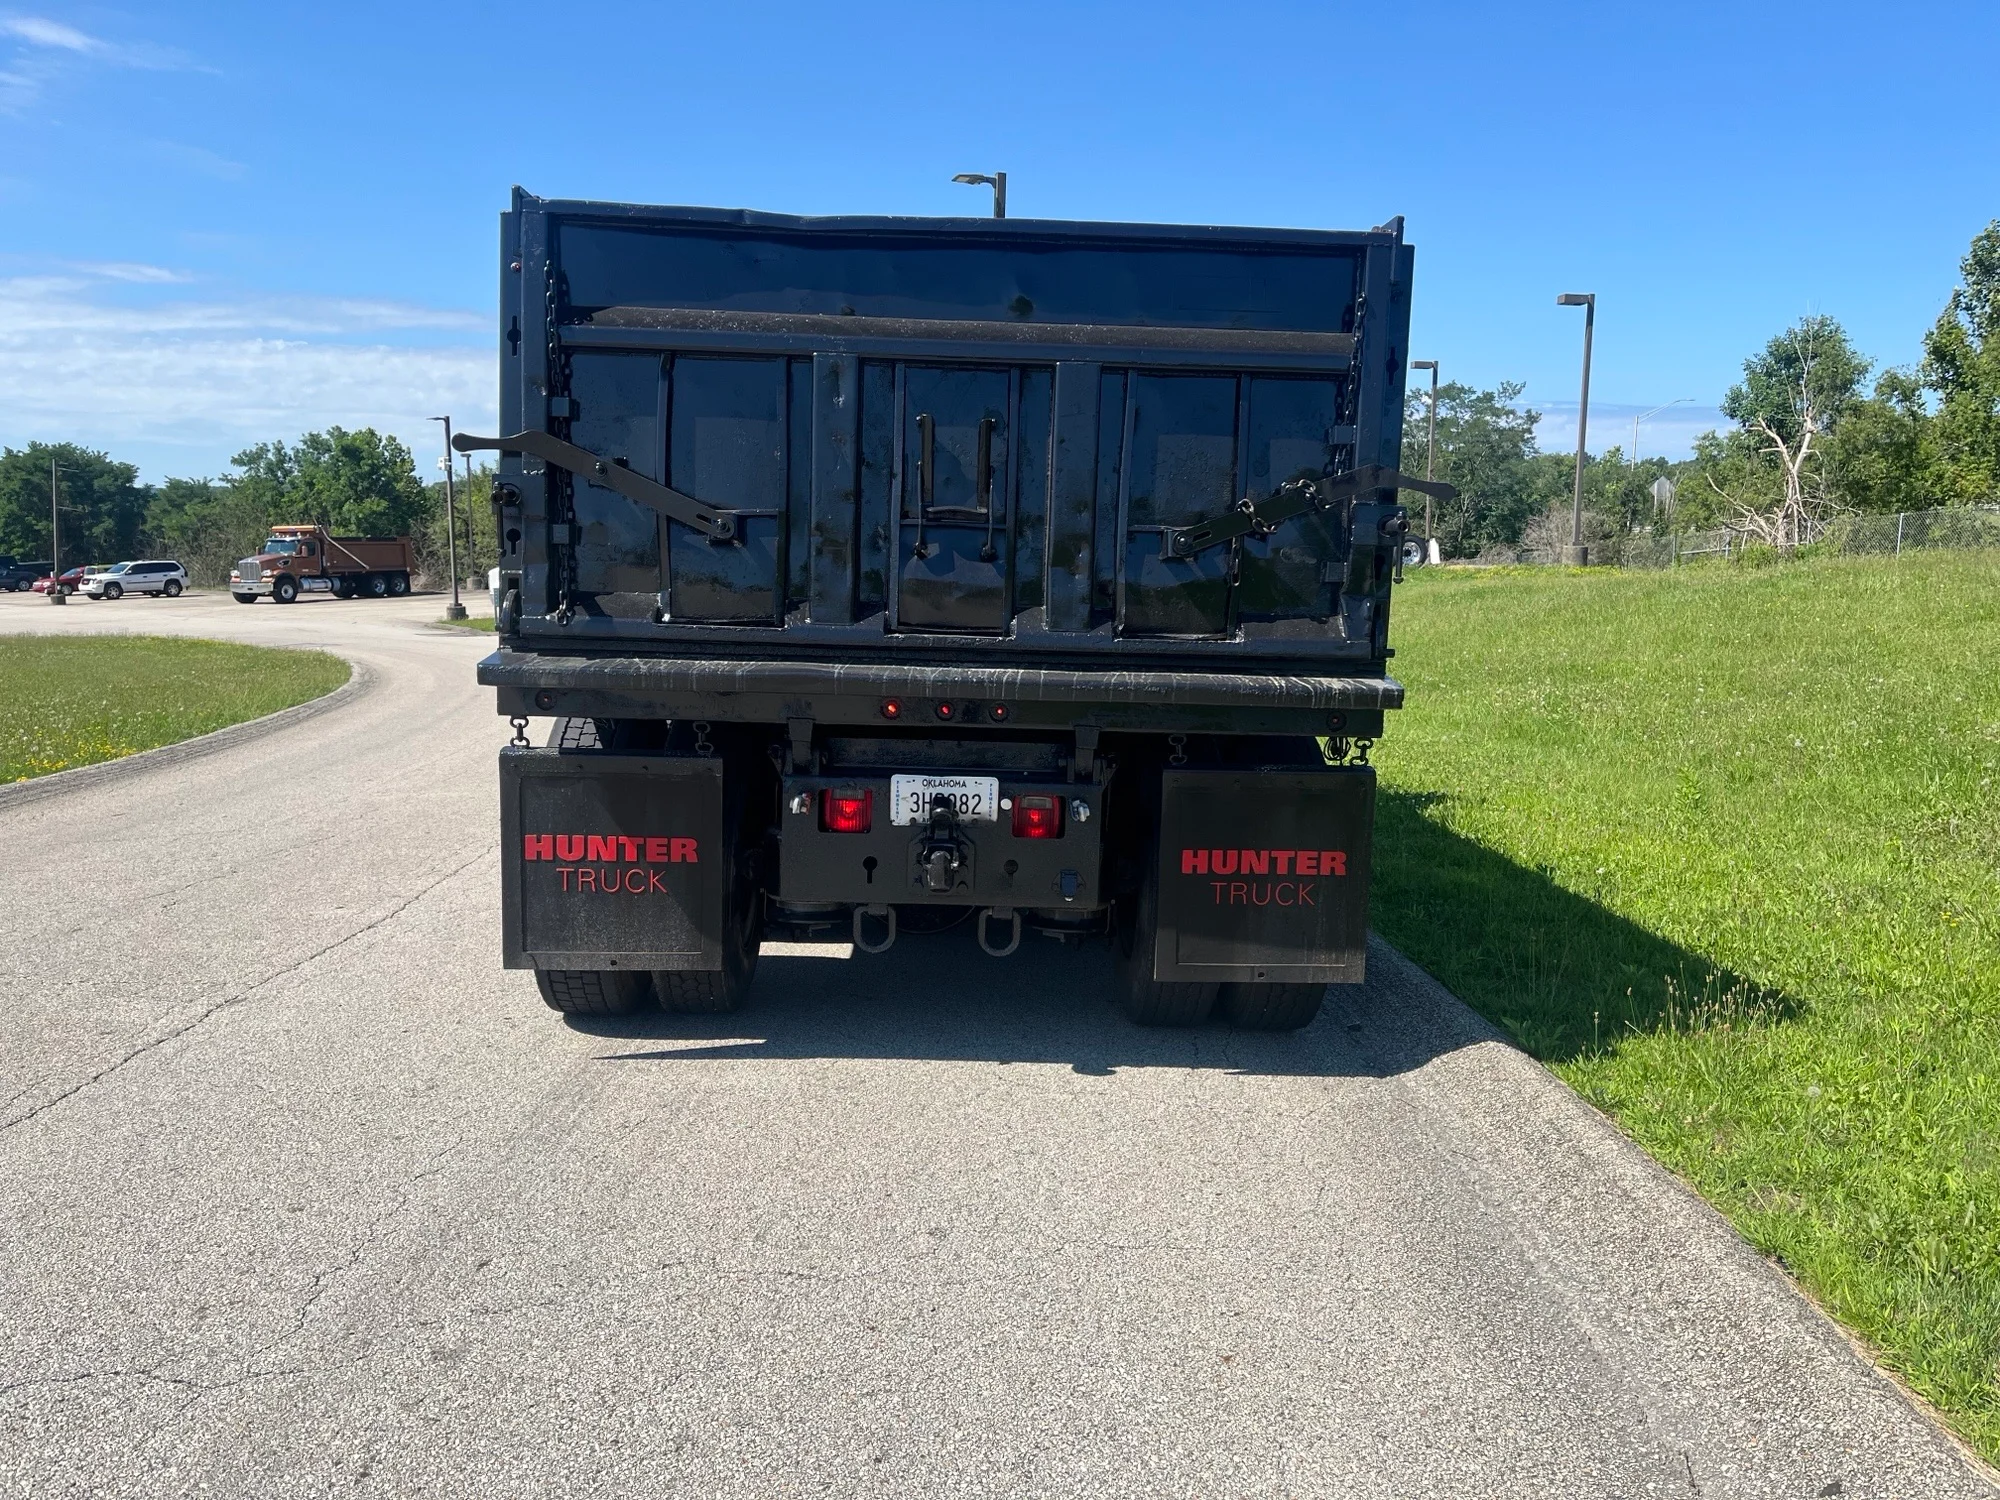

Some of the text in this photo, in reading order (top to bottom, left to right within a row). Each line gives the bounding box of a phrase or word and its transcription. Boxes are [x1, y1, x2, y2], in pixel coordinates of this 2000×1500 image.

[922, 779, 967, 788] OKLAHOMA
[524, 834, 699, 863] HUNTER
[1181, 849, 1347, 876] HUNTER
[556, 867, 668, 894] TRUCK
[1209, 882, 1316, 906] TRUCK
